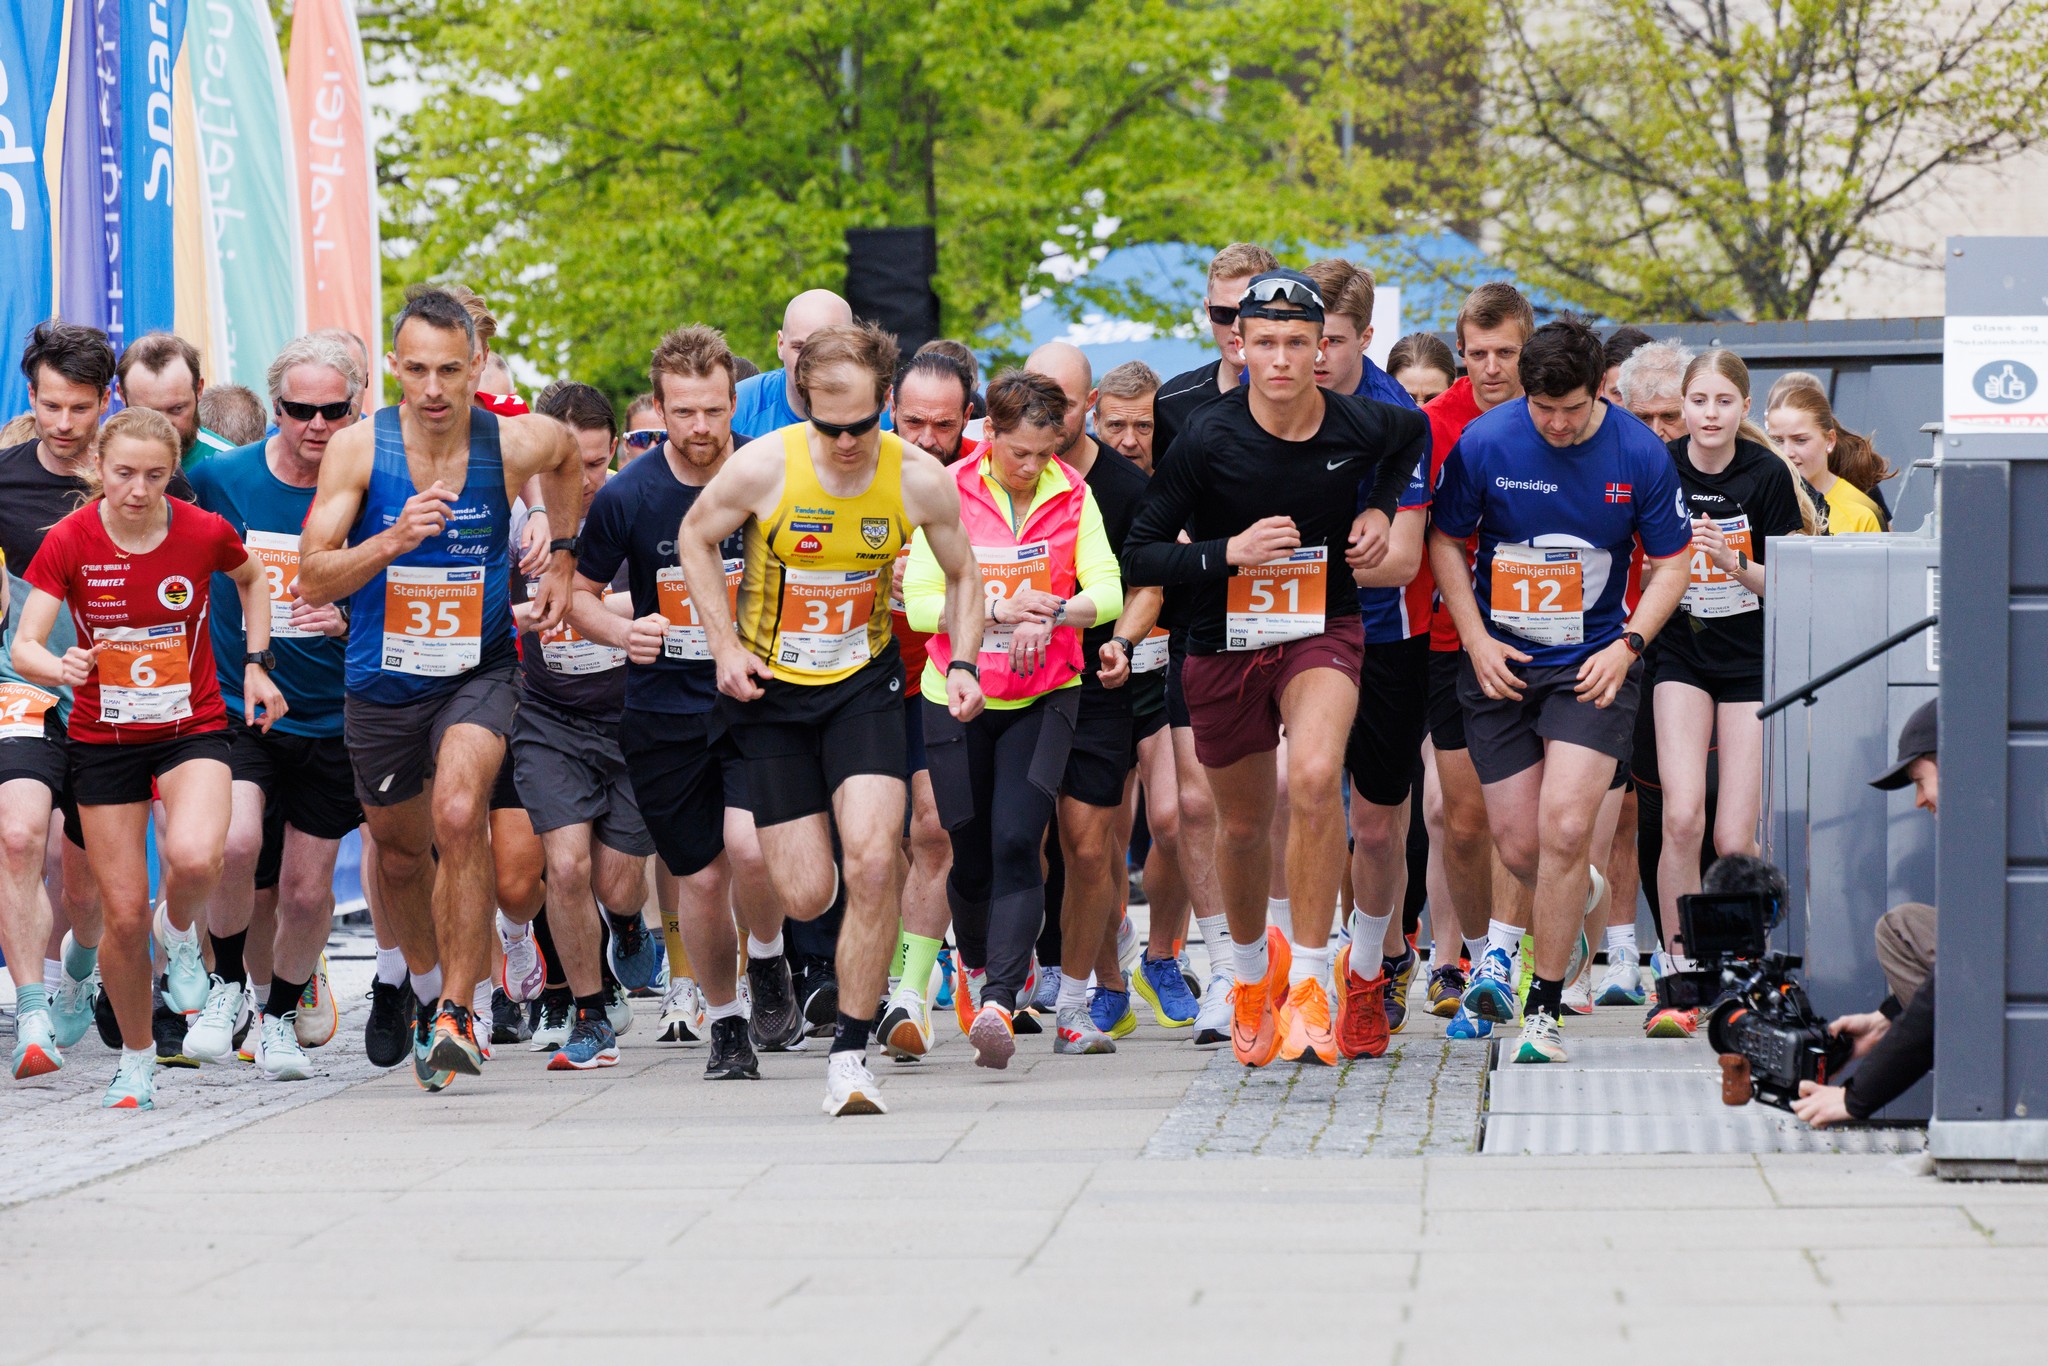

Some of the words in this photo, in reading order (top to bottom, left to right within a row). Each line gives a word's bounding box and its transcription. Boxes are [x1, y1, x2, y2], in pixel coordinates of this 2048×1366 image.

[144, 0, 173, 208] Spar
[1495, 477, 1559, 494] Gjensidige
[451, 507, 477, 515] amdal
[459, 526, 493, 535] GRONG
[800, 541, 818, 549] BM
[251, 549, 301, 566] Steinkjer
[855, 552, 891, 560] TRIMTEX
[979, 560, 1046, 579] einkjermila
[1237, 563, 1321, 578] Steinkjermila
[1497, 562, 1576, 578] Steinkjermila
[87, 578, 126, 587] TRIMTEX
[663, 576, 742, 592] Steiila
[393, 584, 478, 600] Steinkjermila
[791, 582, 872, 600] Steinkjermila
[1248, 578, 1299, 613] 51
[1512, 579, 1563, 612] 12
[87, 599, 127, 608] SOLVINGE
[680, 597, 700, 625] 1
[404, 600, 461, 637] 35
[801, 599, 854, 633] 31
[101, 637, 181, 653] Steinkjermila
[386, 646, 405, 654] ELMAN
[1232, 638, 1246, 646] SSA
[387, 657, 401, 666] SSA
[783, 652, 797, 661] SSA
[130, 654, 157, 687] 6
[0, 685, 52, 704] inkjermila
[105, 709, 118, 718] SSA
